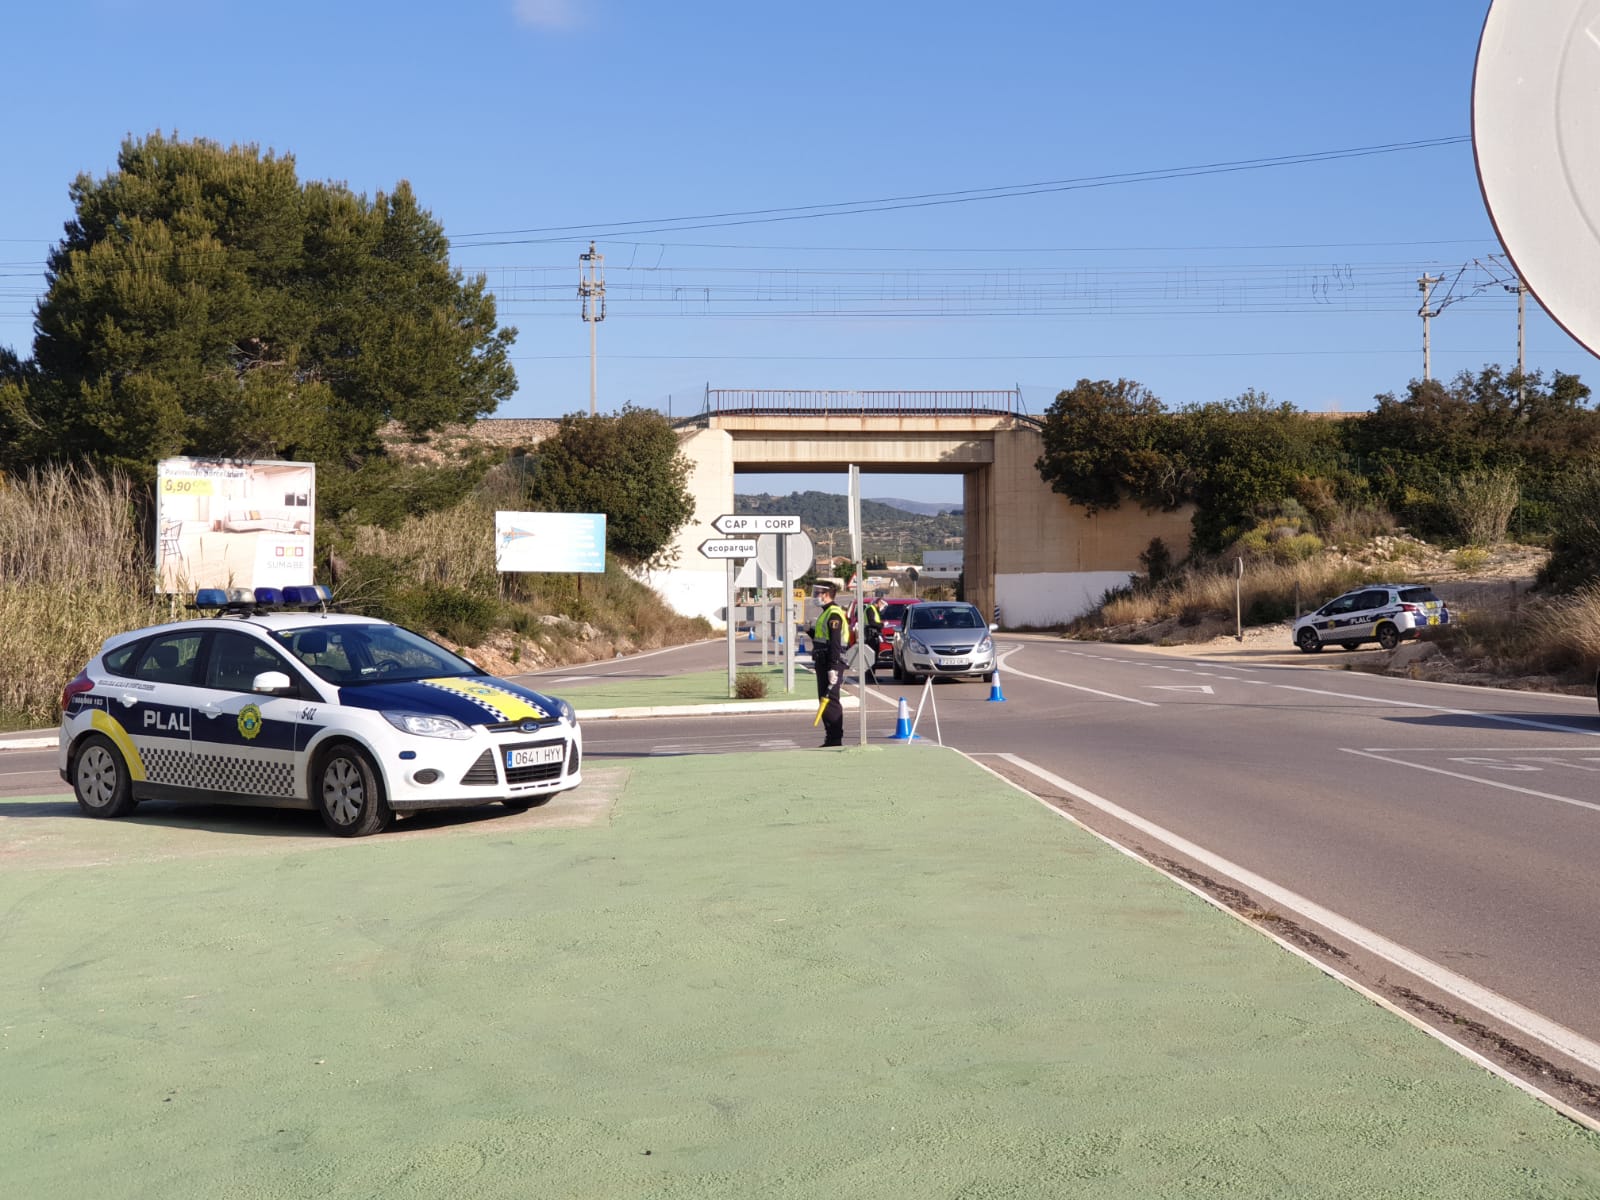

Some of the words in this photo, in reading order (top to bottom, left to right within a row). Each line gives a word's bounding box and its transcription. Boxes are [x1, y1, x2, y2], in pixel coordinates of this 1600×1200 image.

[725, 520, 747, 529] CAP
[765, 520, 794, 529] CORP
[708, 545, 754, 553] ecoparque
[144, 710, 190, 731] PLAL
[516, 751, 539, 765] 0641
[544, 747, 561, 761] HYY
